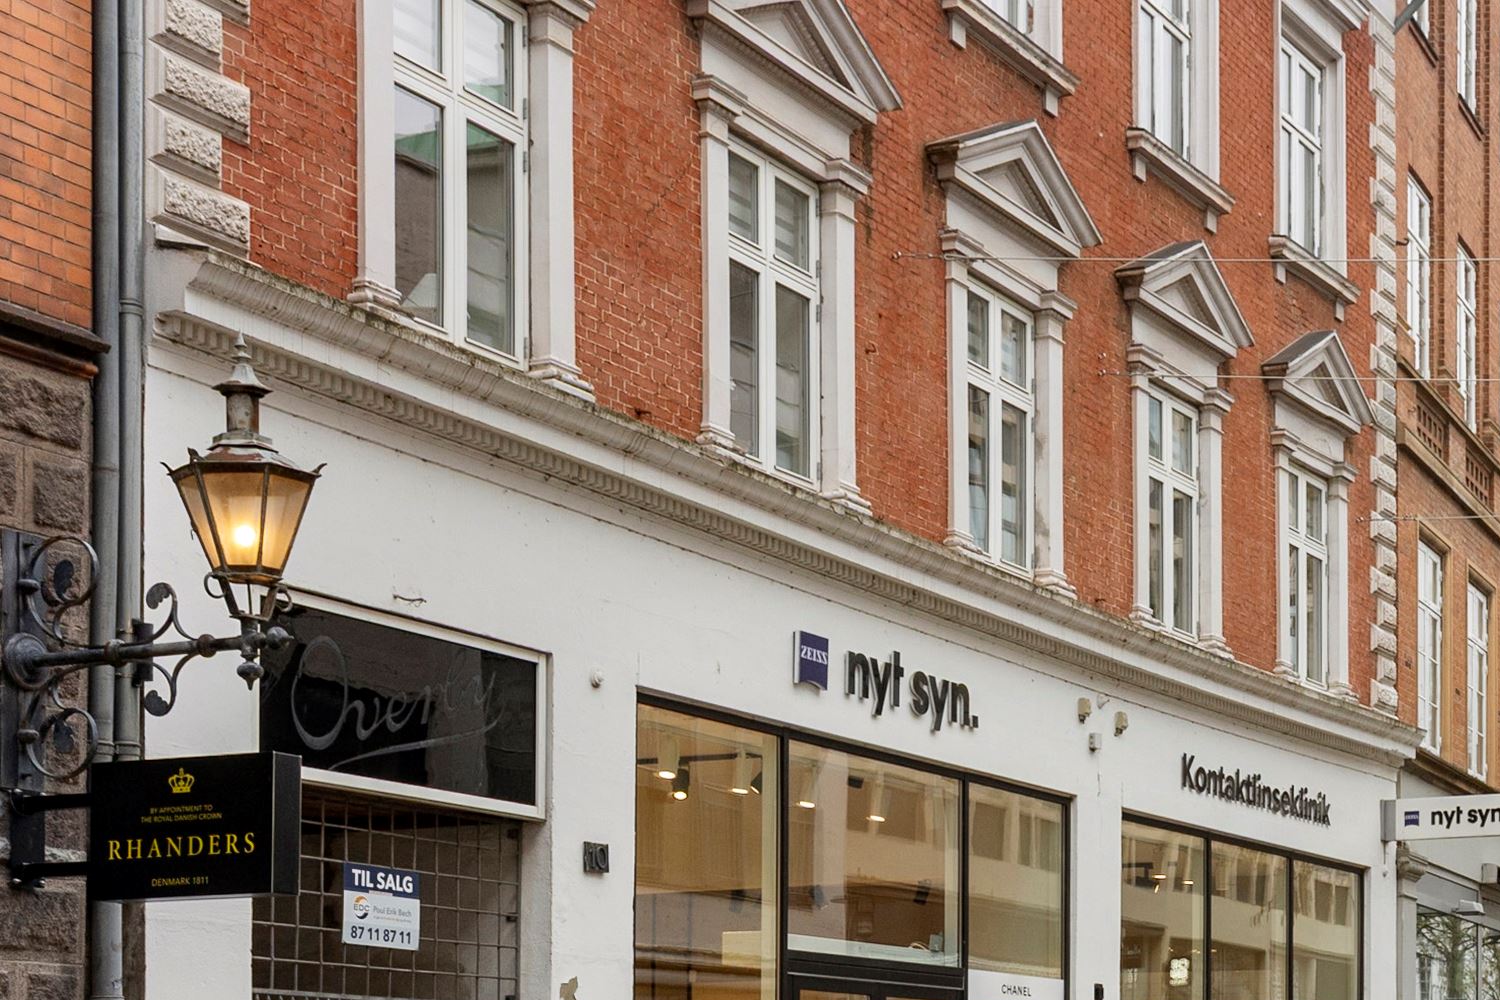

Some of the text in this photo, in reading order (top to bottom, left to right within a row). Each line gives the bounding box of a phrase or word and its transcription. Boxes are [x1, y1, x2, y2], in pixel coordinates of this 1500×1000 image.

[800, 644, 828, 665] ZEISS
[844, 650, 979, 732] nyt syn.
[1181, 752, 1331, 827] Kontaktlinseklinik
[153, 815, 173, 823] ROYAL
[174, 813, 198, 822] DANISH
[198, 812, 222, 820] CROWN
[158, 805, 202, 814] APPOINTMENT
[1430, 806, 1463, 829] nyt
[108, 832, 255, 860] RHANDERS
[151, 876, 209, 887] DENMARK 1811
[351, 868, 414, 893] TIL SALG
[353, 904, 370, 912] EDC
[350, 925, 411, 944] 87 11 87 11
[1001, 984, 1032, 997] CHANEL
